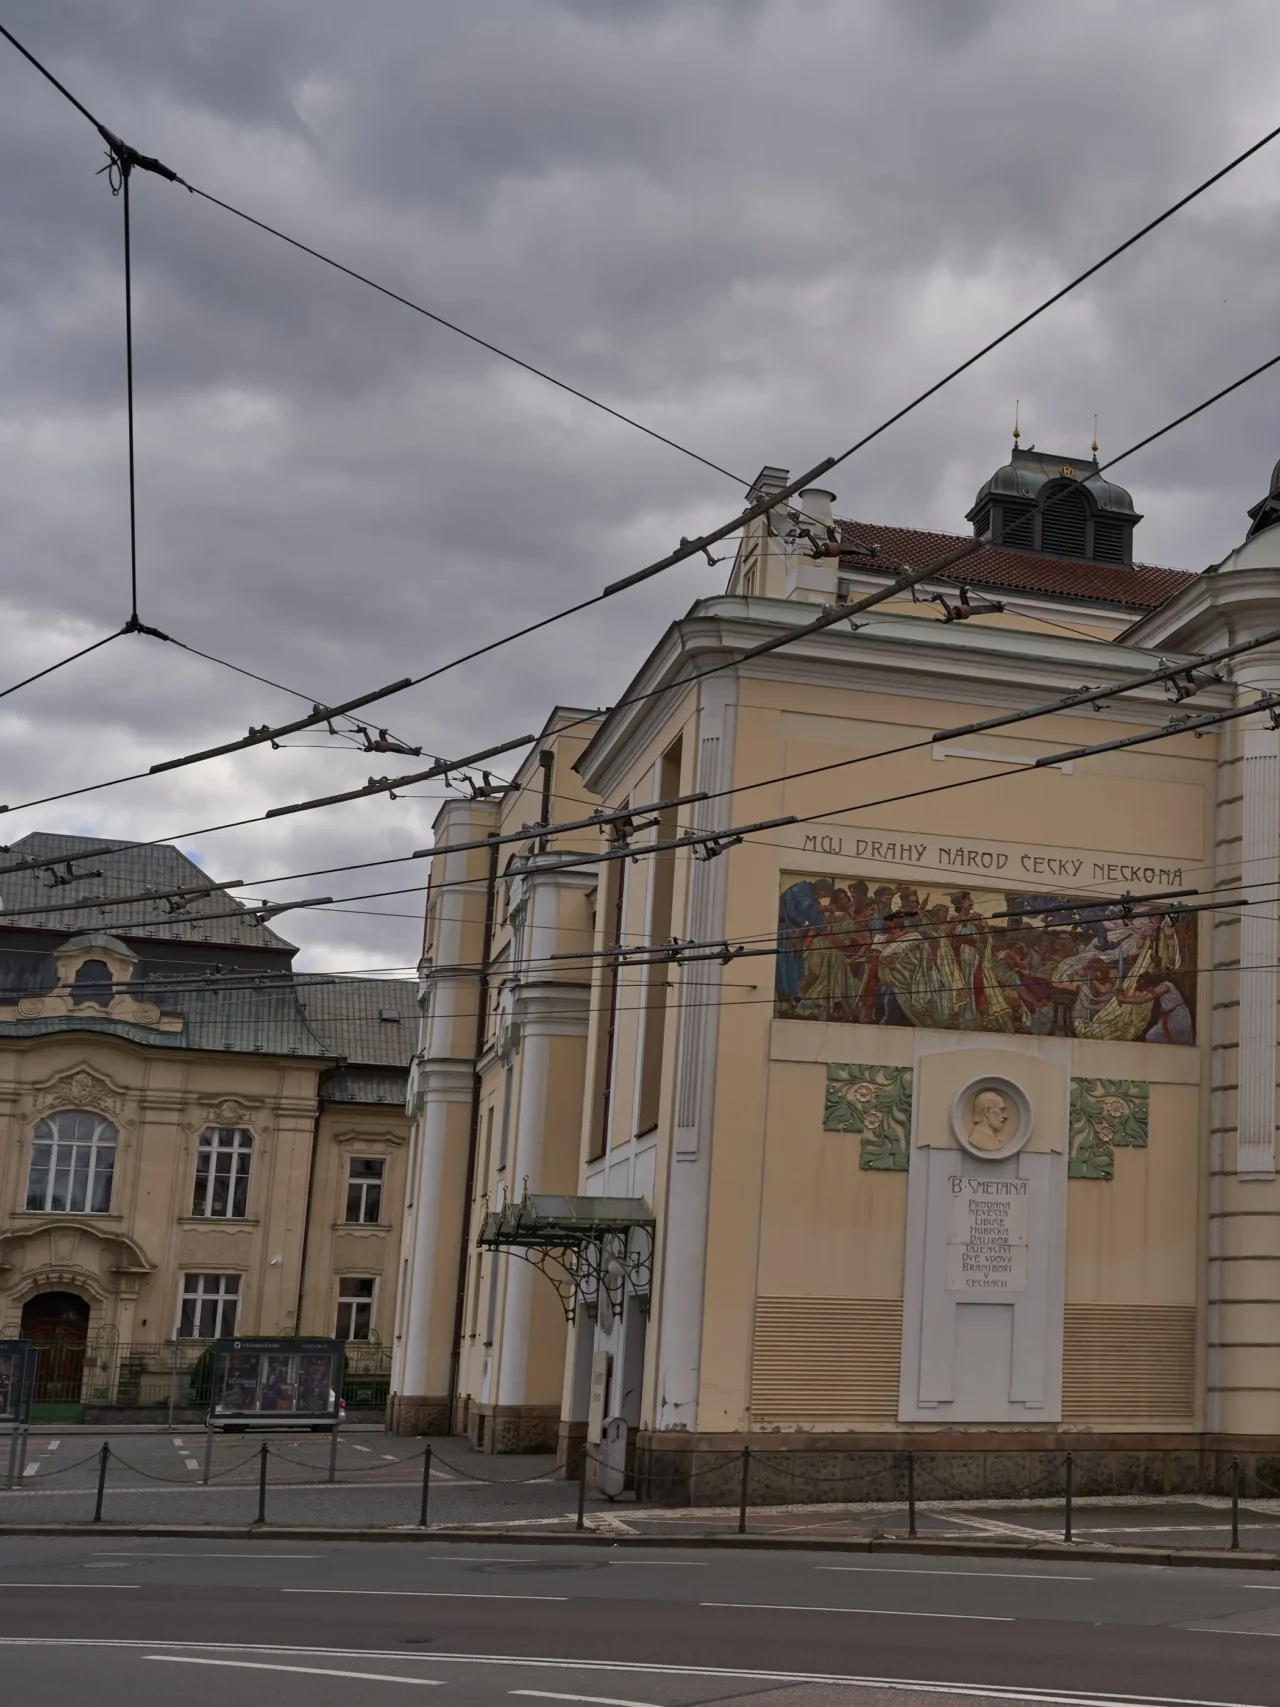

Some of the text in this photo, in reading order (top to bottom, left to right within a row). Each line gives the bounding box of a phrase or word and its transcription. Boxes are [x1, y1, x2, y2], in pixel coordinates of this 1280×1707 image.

[855, 839, 927, 861] DRAHÝ
[939, 846, 1009, 869] NÁROD
[1020, 853, 1084, 877] ČESKÝ
[967, 1178, 1027, 1195] SMETANA
[970, 1234, 1009, 1245] DALIBOR
[985, 1255, 1012, 1263] VDOVY
